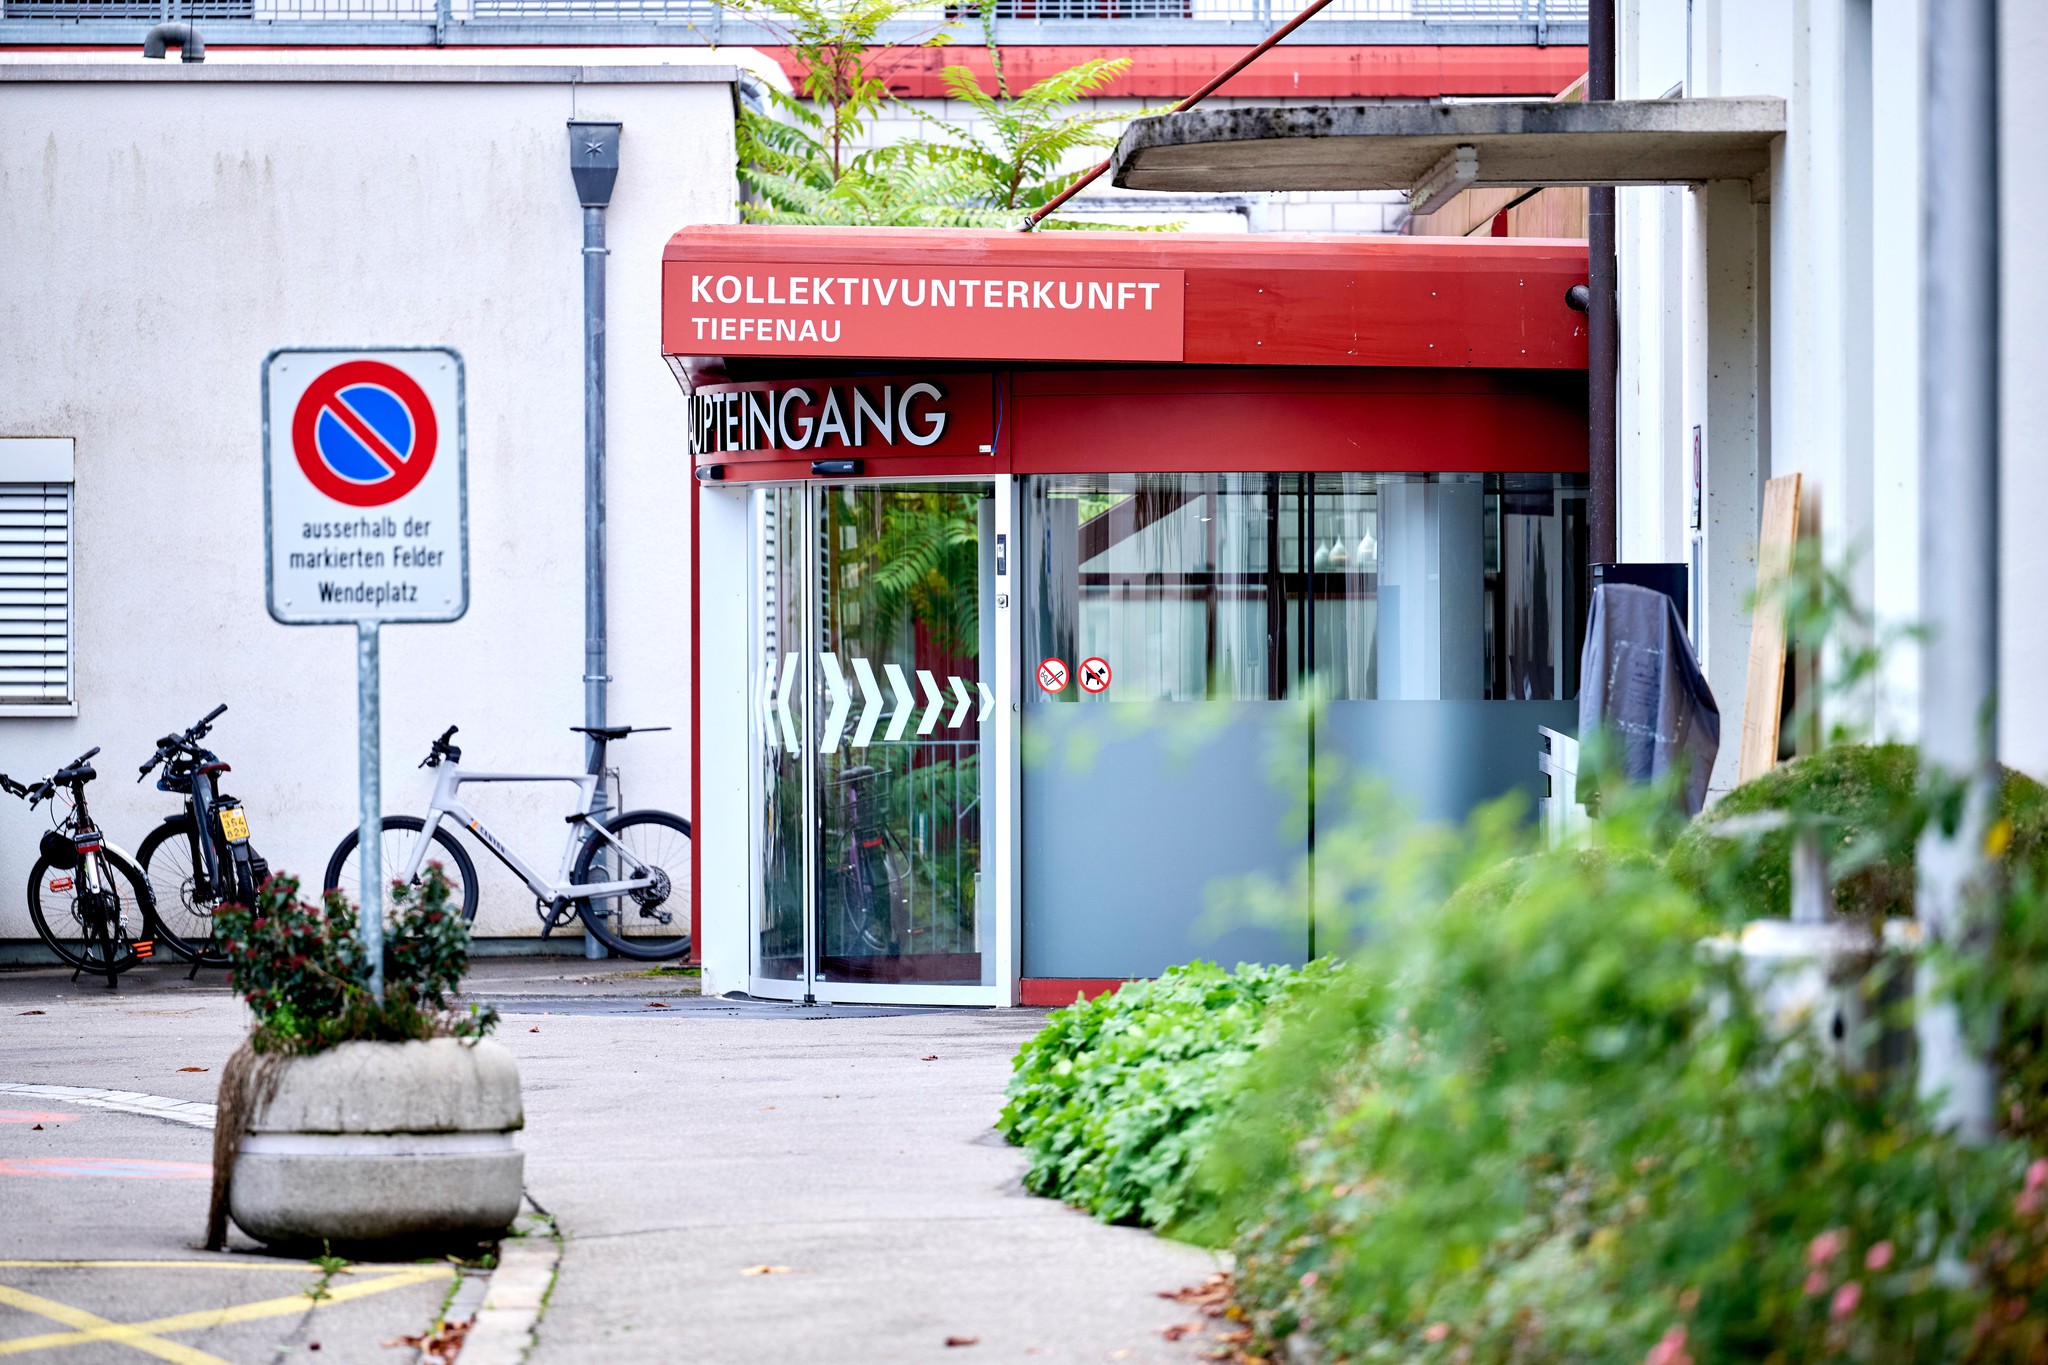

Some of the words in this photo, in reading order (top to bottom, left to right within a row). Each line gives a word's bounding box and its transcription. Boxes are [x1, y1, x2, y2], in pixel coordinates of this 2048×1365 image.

[691, 275, 1161, 310] KOLLEKTIVUNTERKUNFT
[692, 317, 841, 343] TIEFENAU
[302, 517, 397, 539] ausserhalb
[404, 517, 431, 538] der
[289, 547, 385, 569] markierten
[393, 546, 444, 568] Felder
[318, 581, 418, 608] Wendeplatz
